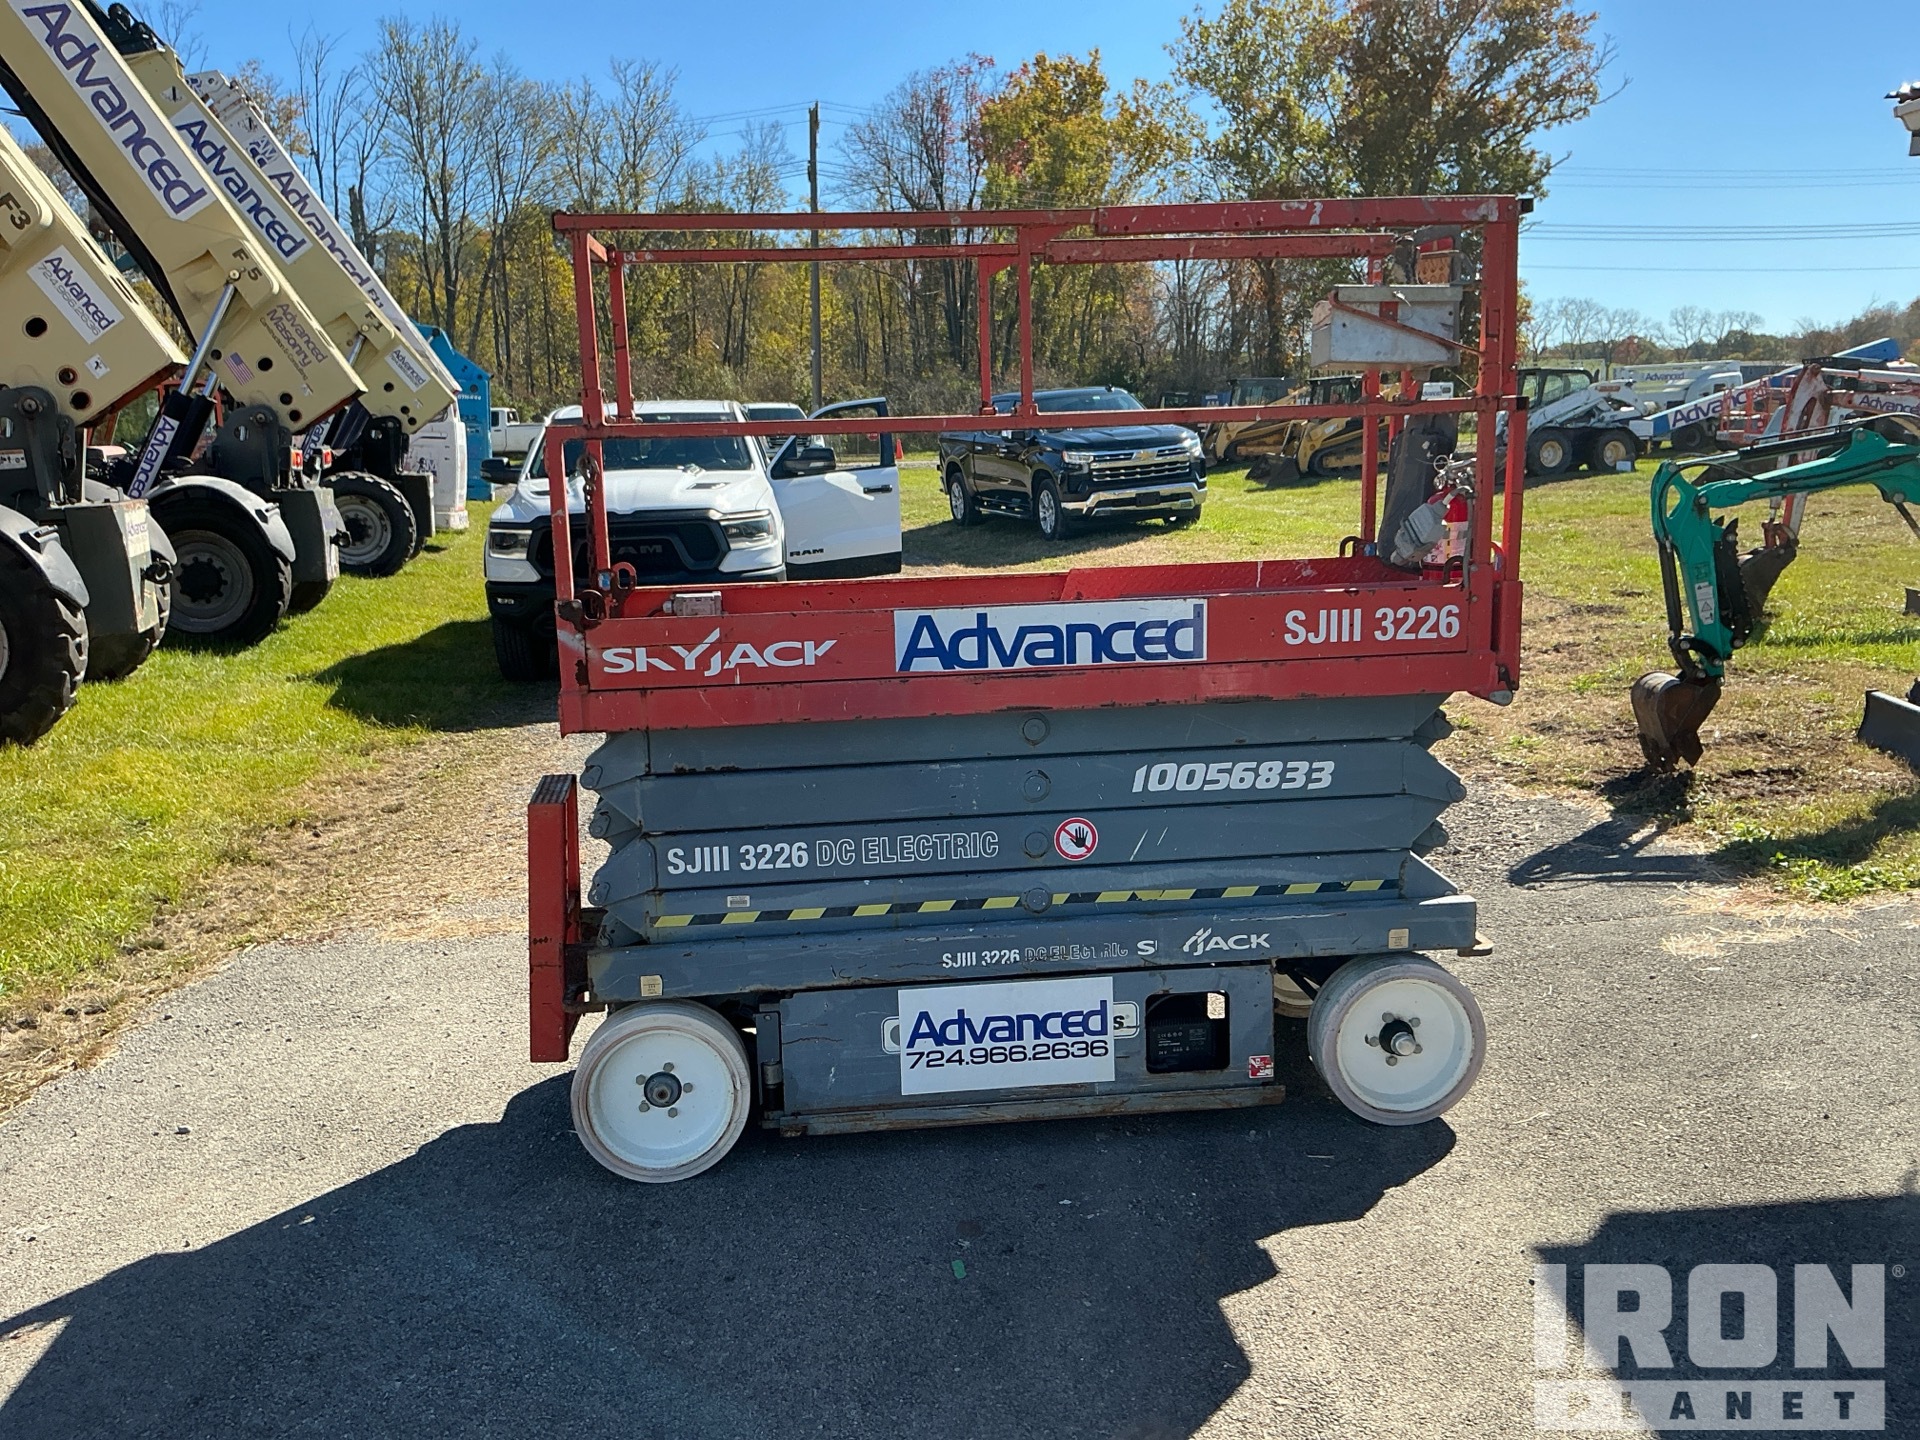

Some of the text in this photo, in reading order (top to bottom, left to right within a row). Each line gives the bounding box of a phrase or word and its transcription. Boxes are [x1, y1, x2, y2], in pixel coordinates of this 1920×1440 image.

[22, 3, 208, 215] Advanced
[0, 192, 31, 231] F3
[175, 120, 307, 259] Advanced
[269, 171, 372, 287] Advanced
[44, 256, 116, 331] Advanced
[266, 308, 312, 367] Masonry
[277, 303, 328, 363] Advanced
[1672, 388, 1756, 427] Advanc
[1859, 394, 1920, 415] Advance
[789, 548, 824, 557] RAM
[898, 603, 1204, 672] Advanced
[1284, 604, 1460, 645] SJIII 3226
[602, 627, 838, 677] SKYJACK
[1132, 760, 1335, 793] 10056833
[667, 831, 999, 875] SJIII 3226 DC ELECTRIC
[942, 951, 976, 969] SJIII
[981, 949, 1020, 966] 3226
[906, 999, 1109, 1049] Advanced
[906, 1039, 1110, 1069] 724.966.2636
